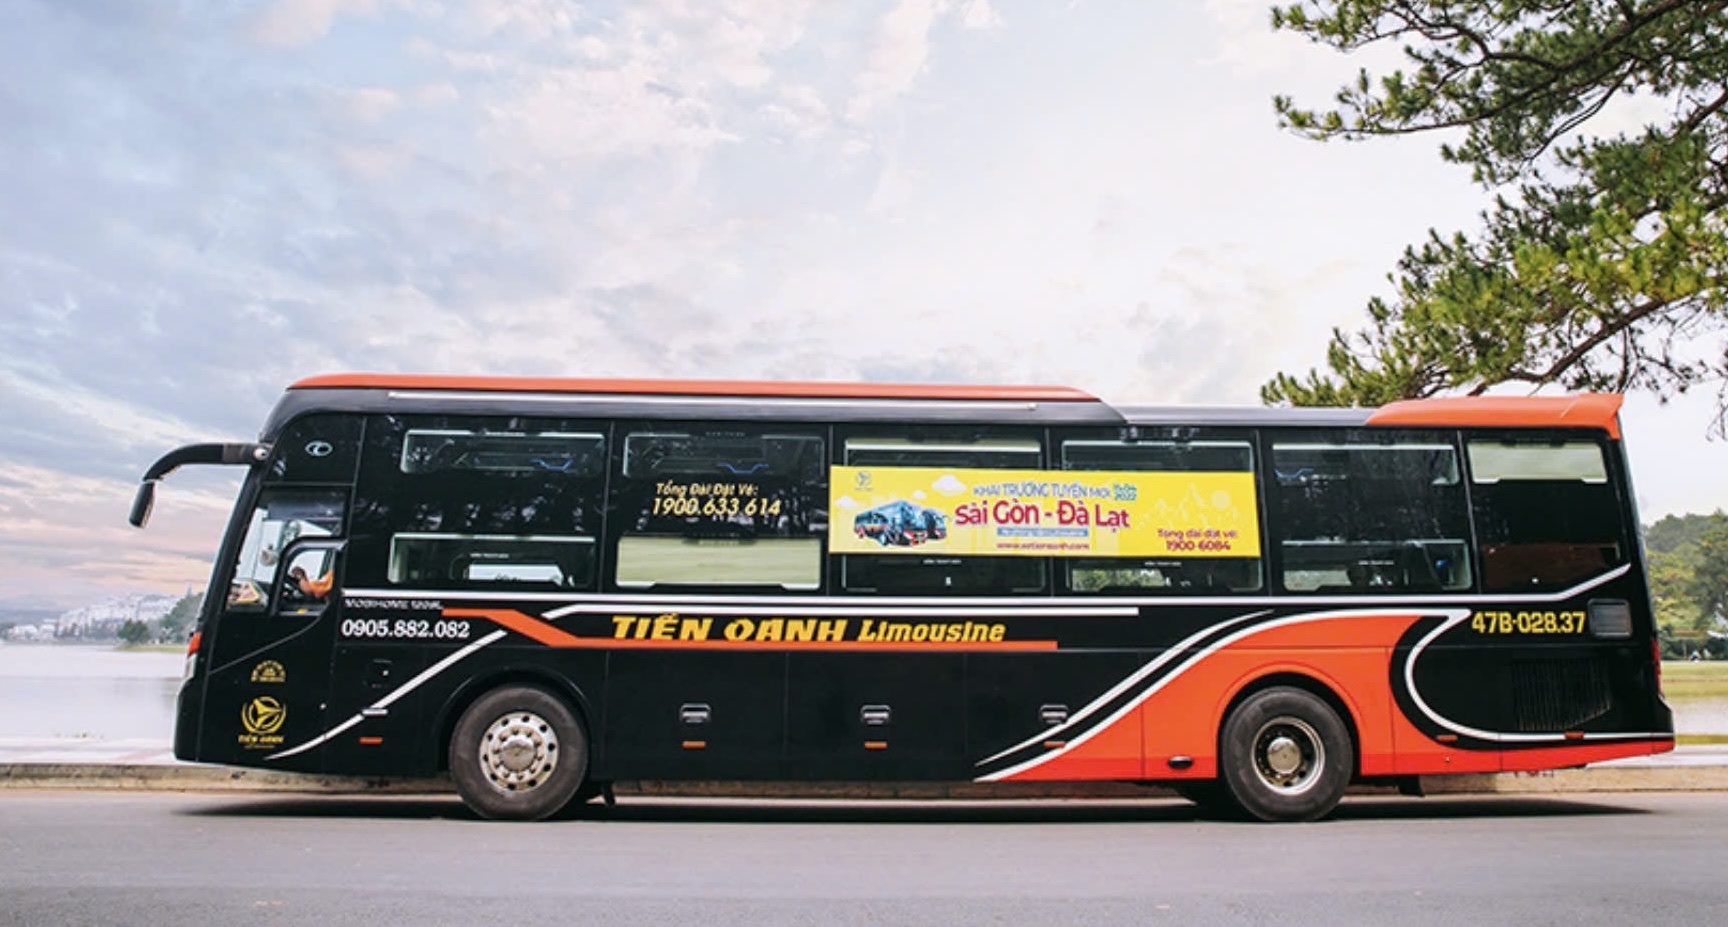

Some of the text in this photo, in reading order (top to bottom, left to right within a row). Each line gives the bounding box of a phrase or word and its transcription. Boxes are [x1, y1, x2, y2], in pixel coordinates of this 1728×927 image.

[973, 485, 1000, 496] KHAI
[653, 497, 781, 516] 1900.633 614
[955, 500, 988, 525] Sài
[993, 498, 1039, 525] Gòn
[1056, 499, 1089, 526] Đà
[1095, 503, 1130, 533] Lạt
[1166, 540, 1231, 551] 1900 6084
[341, 618, 470, 639] 0905.882.082
[612, 612, 1006, 643] TIẾN OANH Limousine
[1471, 610, 1587, 634] 47B-028.37
